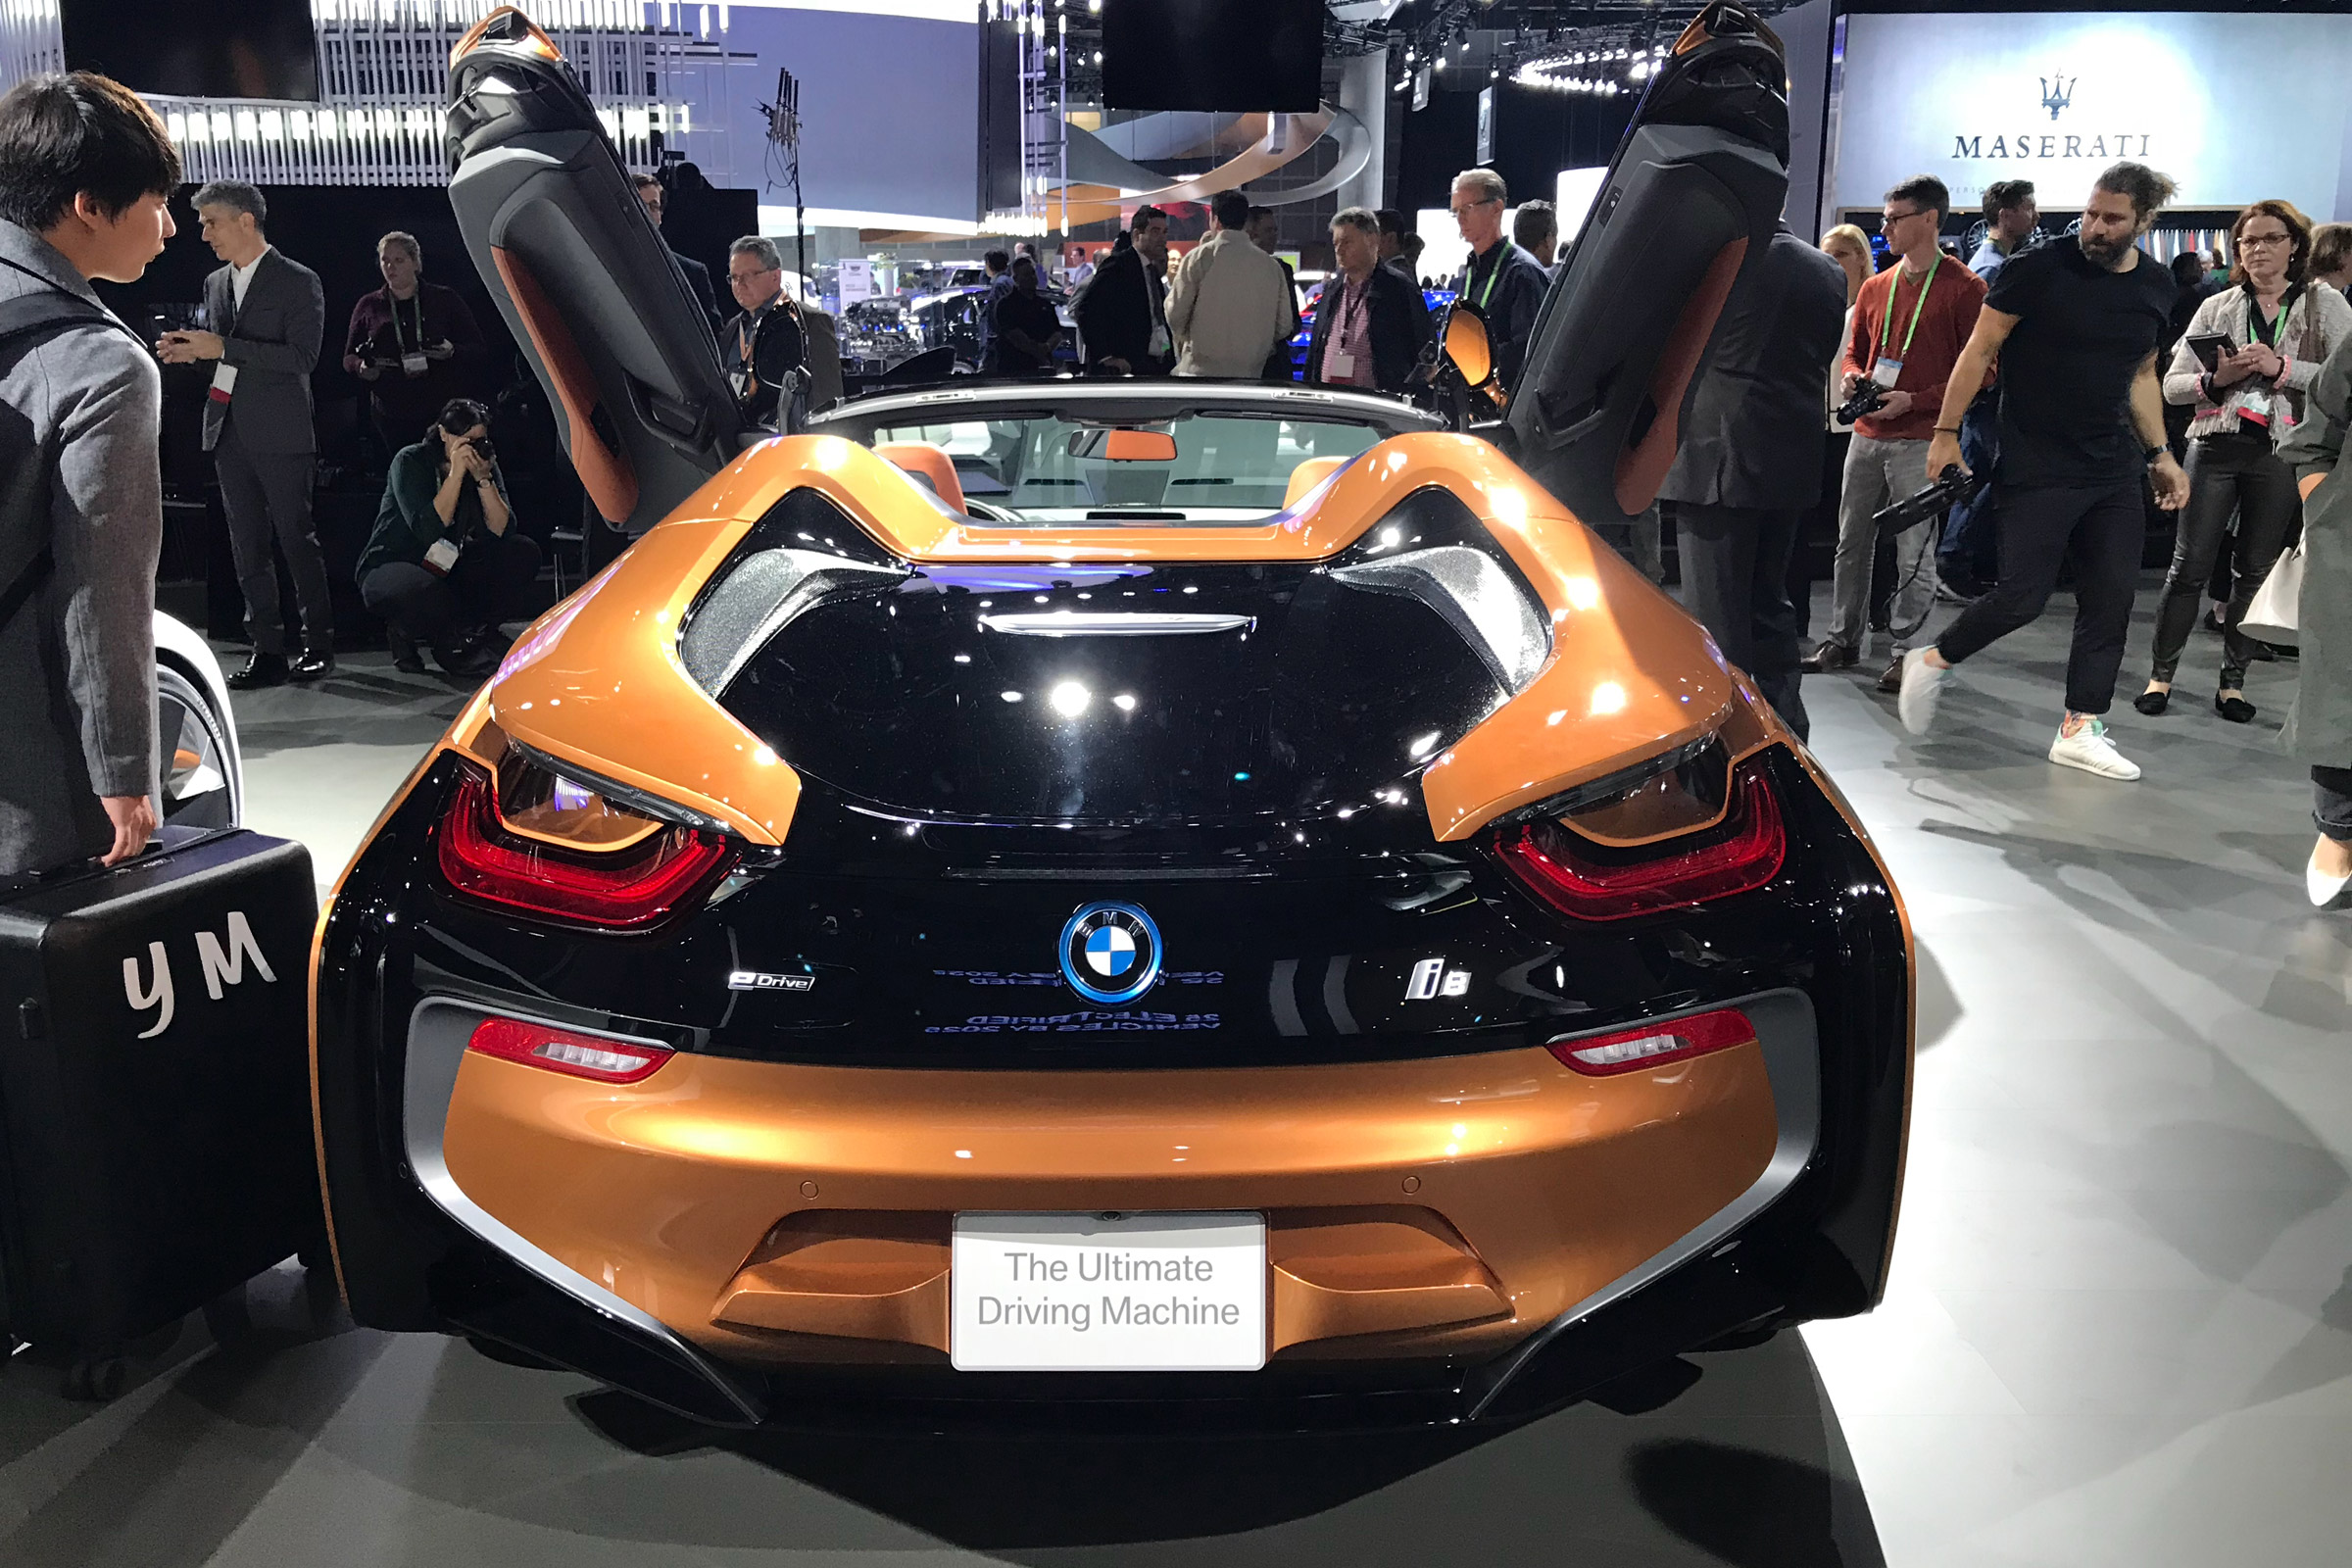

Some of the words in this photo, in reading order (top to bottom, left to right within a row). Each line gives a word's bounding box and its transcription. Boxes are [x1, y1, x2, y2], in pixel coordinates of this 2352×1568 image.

[1951, 134, 2150, 159] MASERATI
[1076, 911, 1145, 938] BMW
[1004, 1252, 1068, 1282] The
[1079, 1252, 1213, 1282] Ultimate
[978, 1296, 1091, 1333] Driving
[1102, 1296, 1240, 1326] Machine
